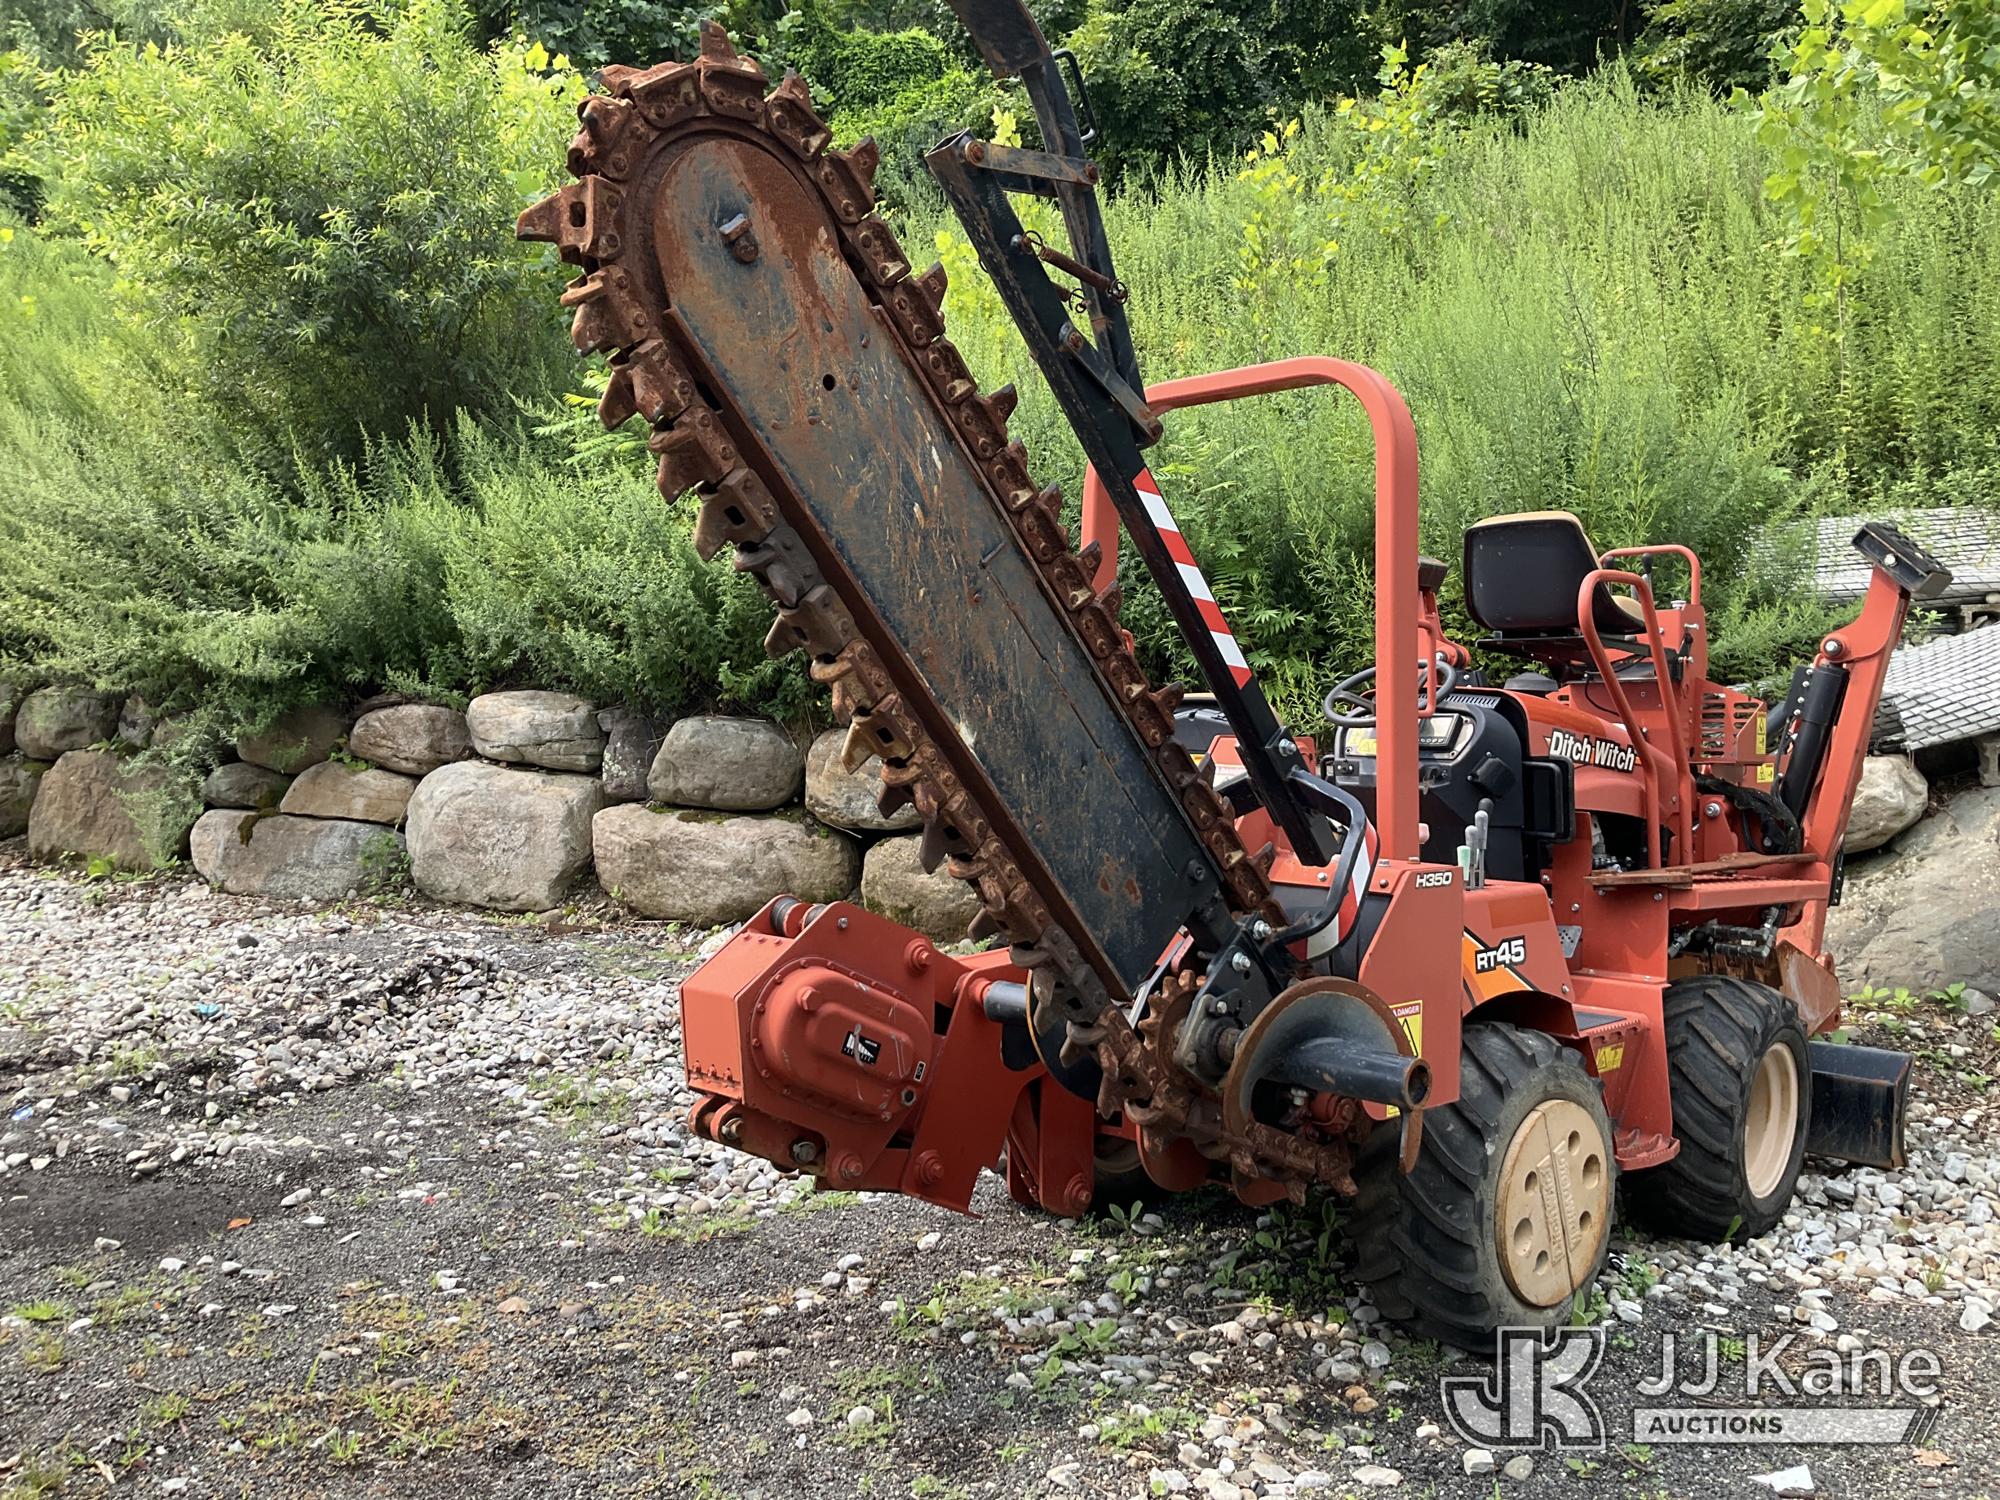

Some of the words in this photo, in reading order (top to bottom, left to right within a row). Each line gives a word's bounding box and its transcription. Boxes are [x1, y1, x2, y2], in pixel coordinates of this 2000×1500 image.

[1550, 729, 1592, 763] Ditch
[1595, 739, 1635, 772] Witch
[1415, 871, 1453, 888] H350
[1476, 938, 1526, 970] RT45
